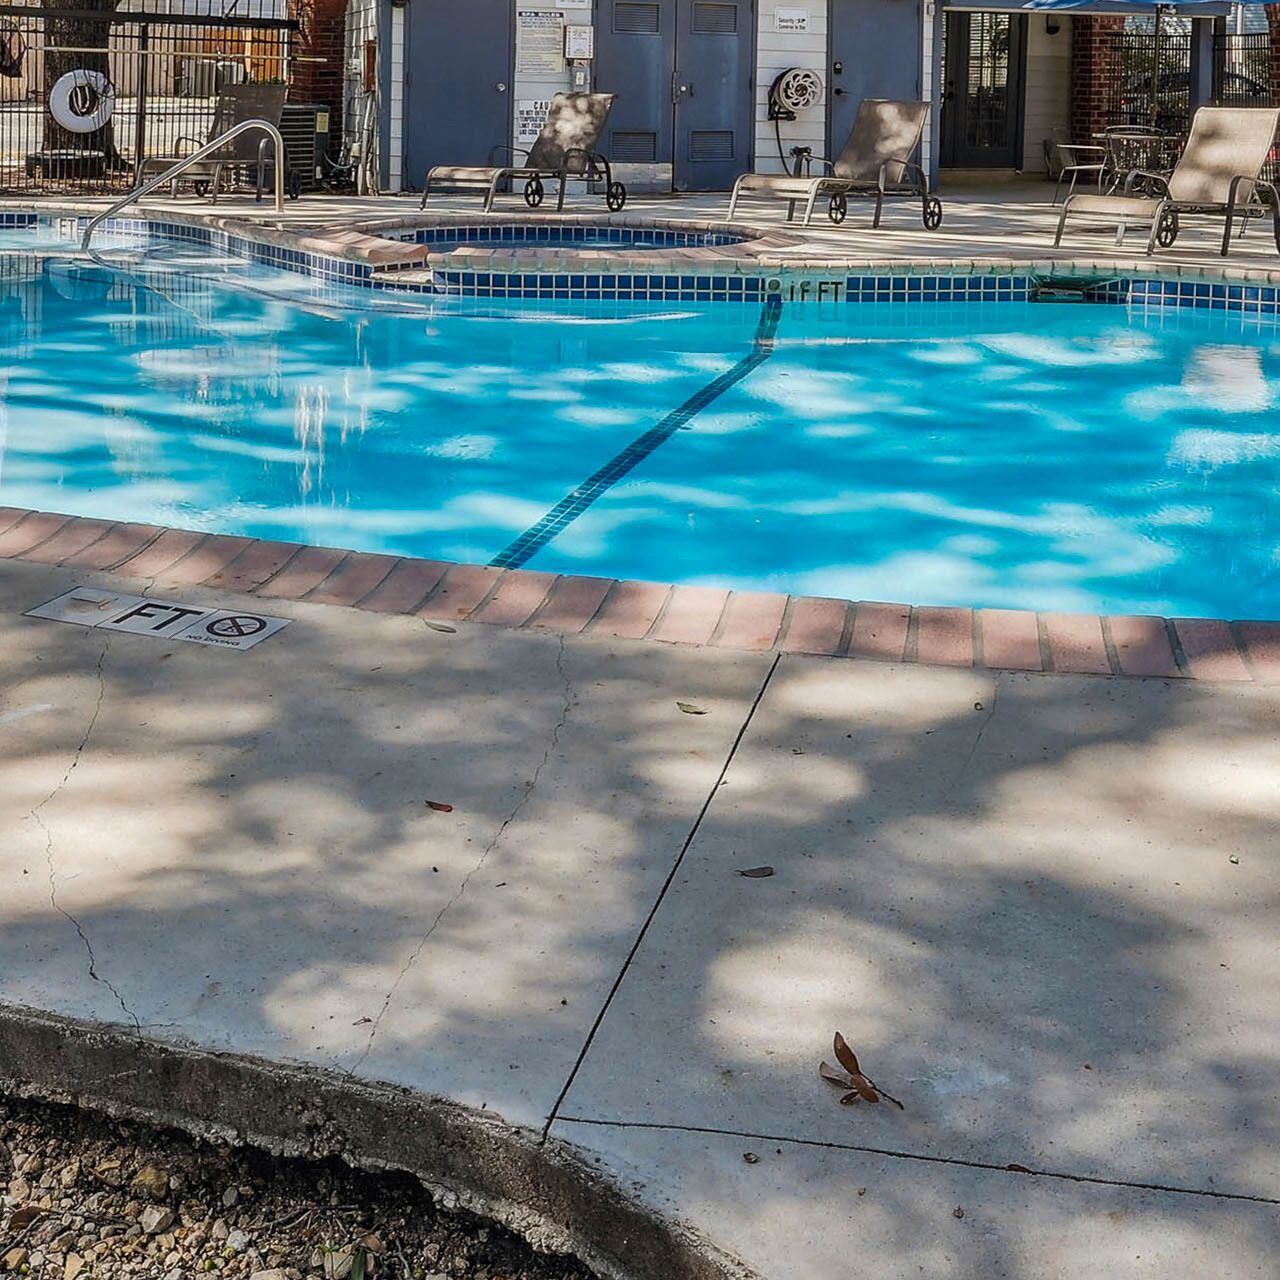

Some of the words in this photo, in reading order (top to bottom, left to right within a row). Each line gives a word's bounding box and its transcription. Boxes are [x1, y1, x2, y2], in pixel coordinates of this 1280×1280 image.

[818, 281, 843, 302] FT
[112, 602, 205, 631] FT
[186, 634, 202, 642] NO
[204, 637, 241, 646] DIVING
